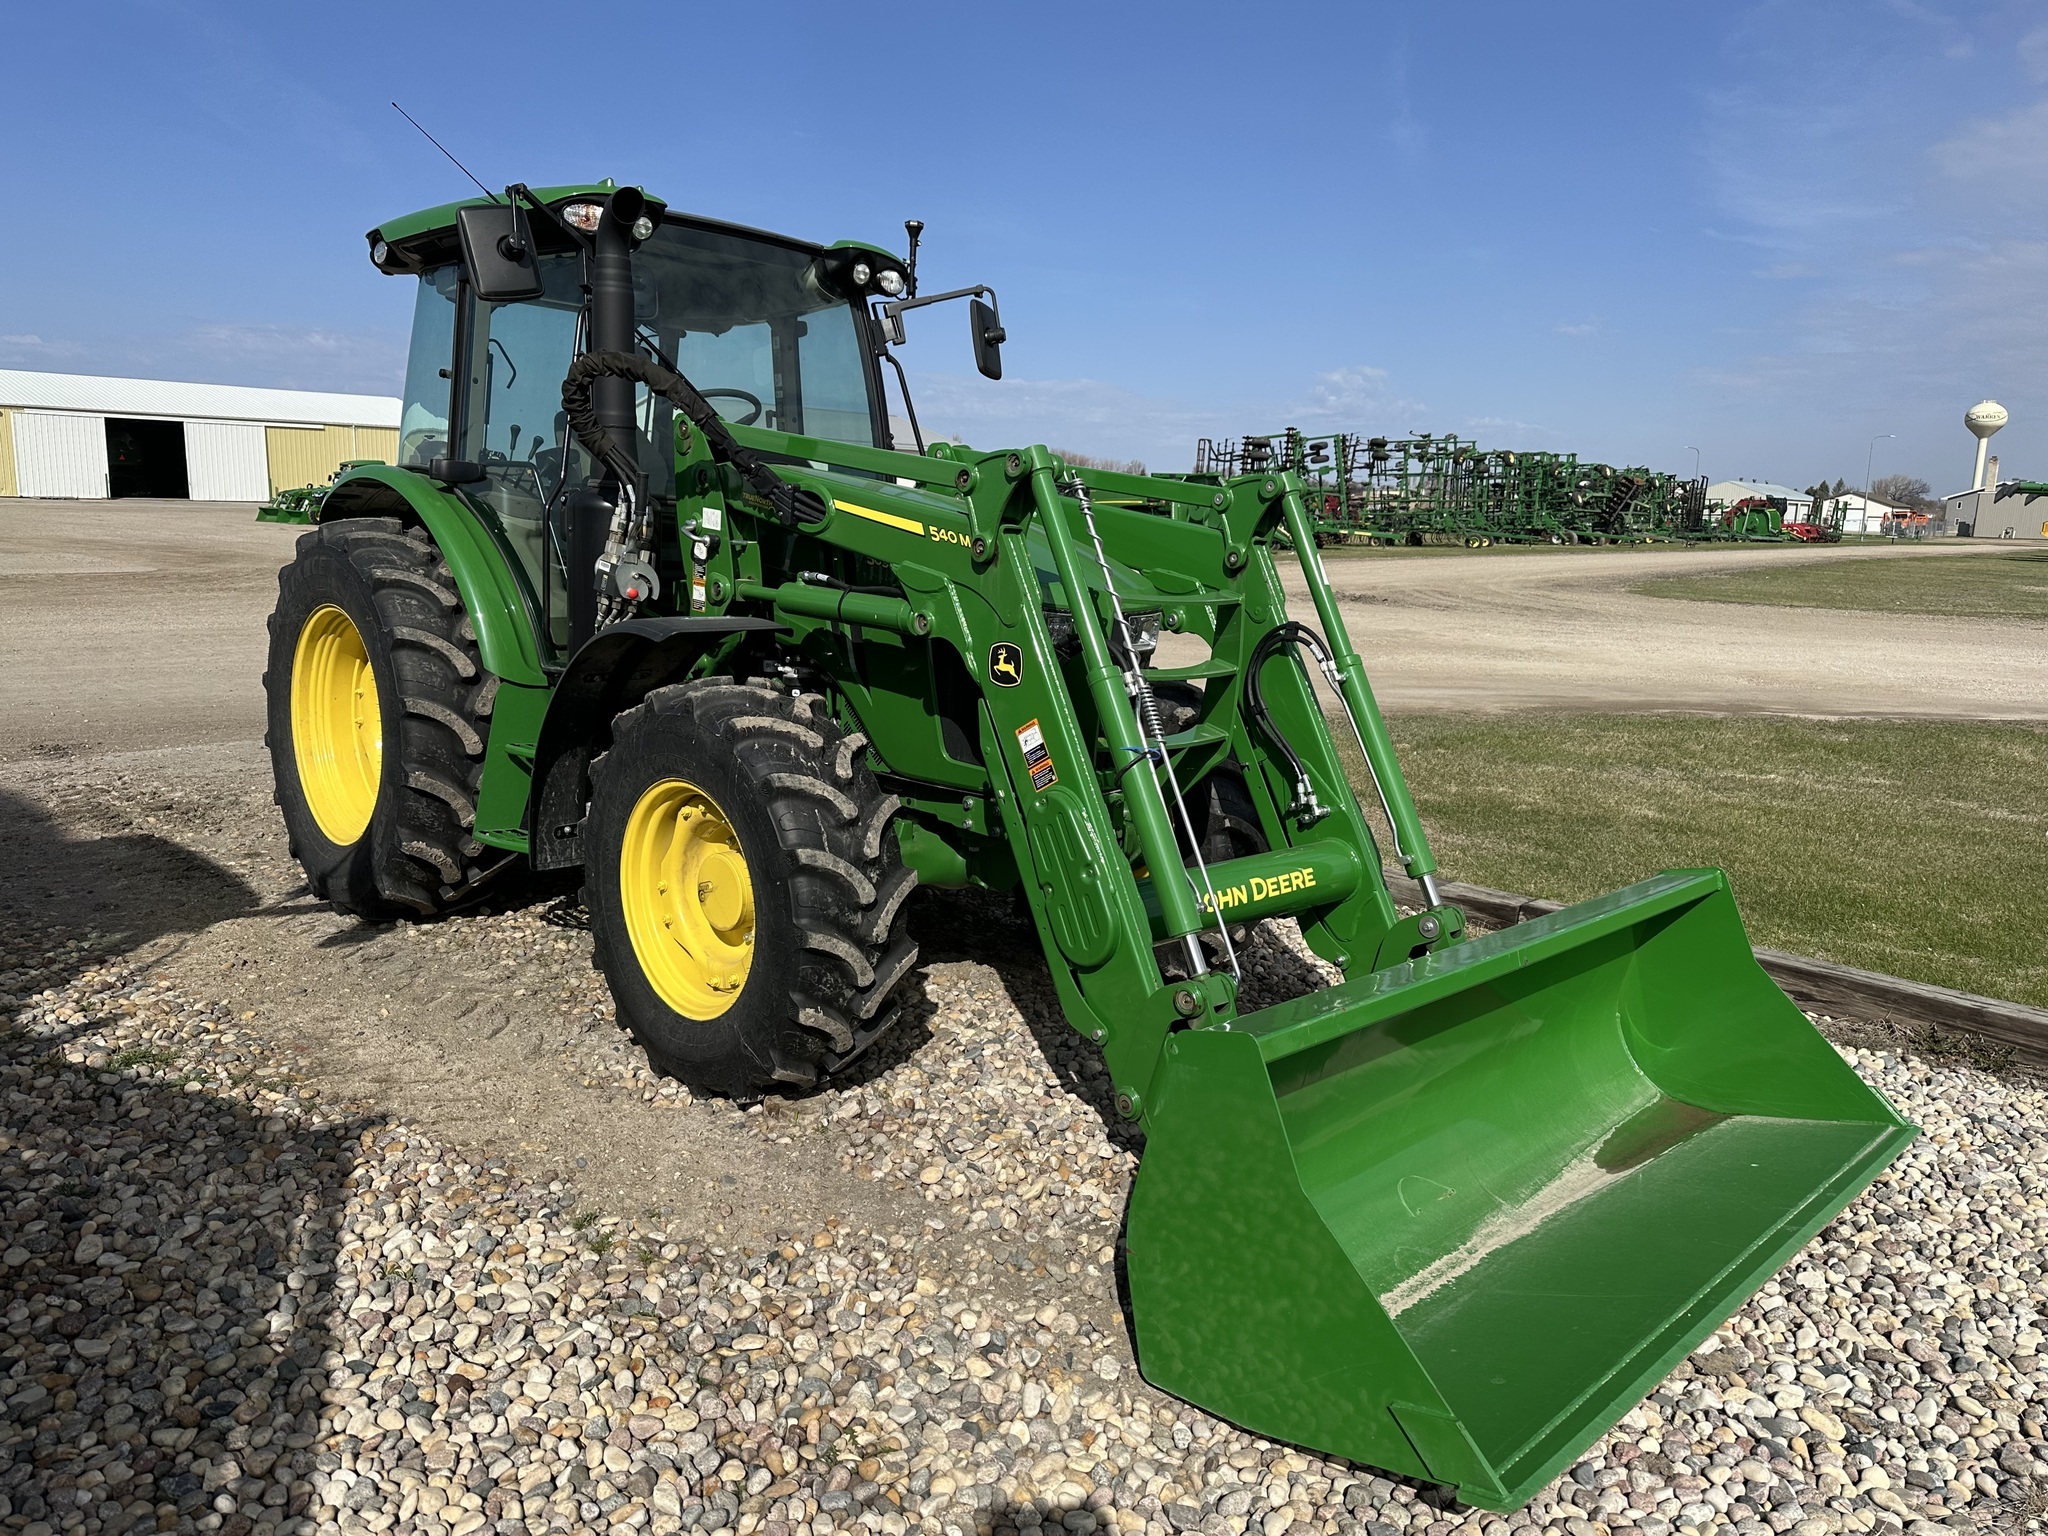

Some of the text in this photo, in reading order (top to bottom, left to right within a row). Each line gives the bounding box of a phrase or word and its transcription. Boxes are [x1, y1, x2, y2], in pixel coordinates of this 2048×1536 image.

[928, 525, 958, 545] 540
[1203, 867, 1317, 913] OHN DEERE
